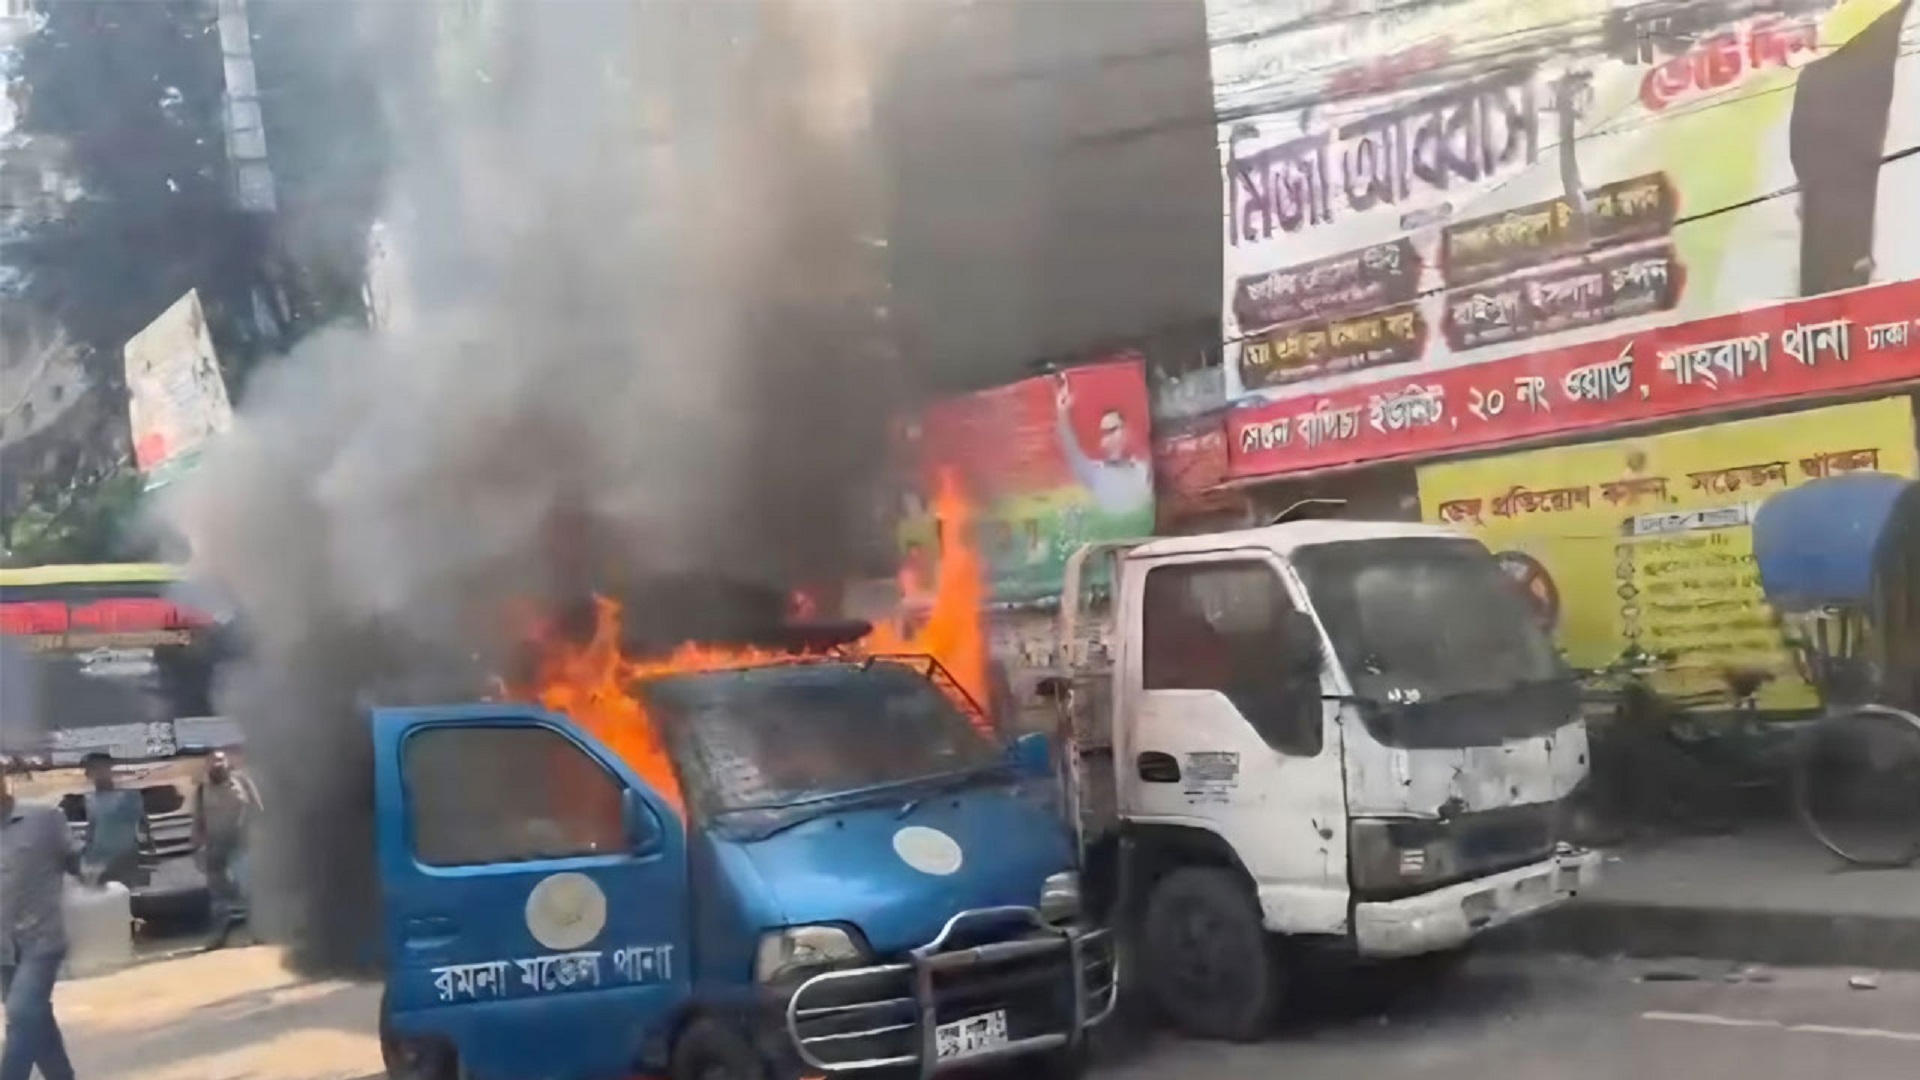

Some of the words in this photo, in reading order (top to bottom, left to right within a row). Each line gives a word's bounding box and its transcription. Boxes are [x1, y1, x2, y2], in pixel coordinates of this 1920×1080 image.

[1468, 386, 1504, 421] ২০
[1514, 376, 1550, 414] নং
[1657, 332, 1769, 390] শাহবাগ
[1781, 317, 1854, 366] থানা
[1864, 320, 1909, 350] ঢাকা
[431, 961, 508, 1002] রমনা
[514, 951, 602, 993] মডেল
[614, 945, 673, 983] থানা
